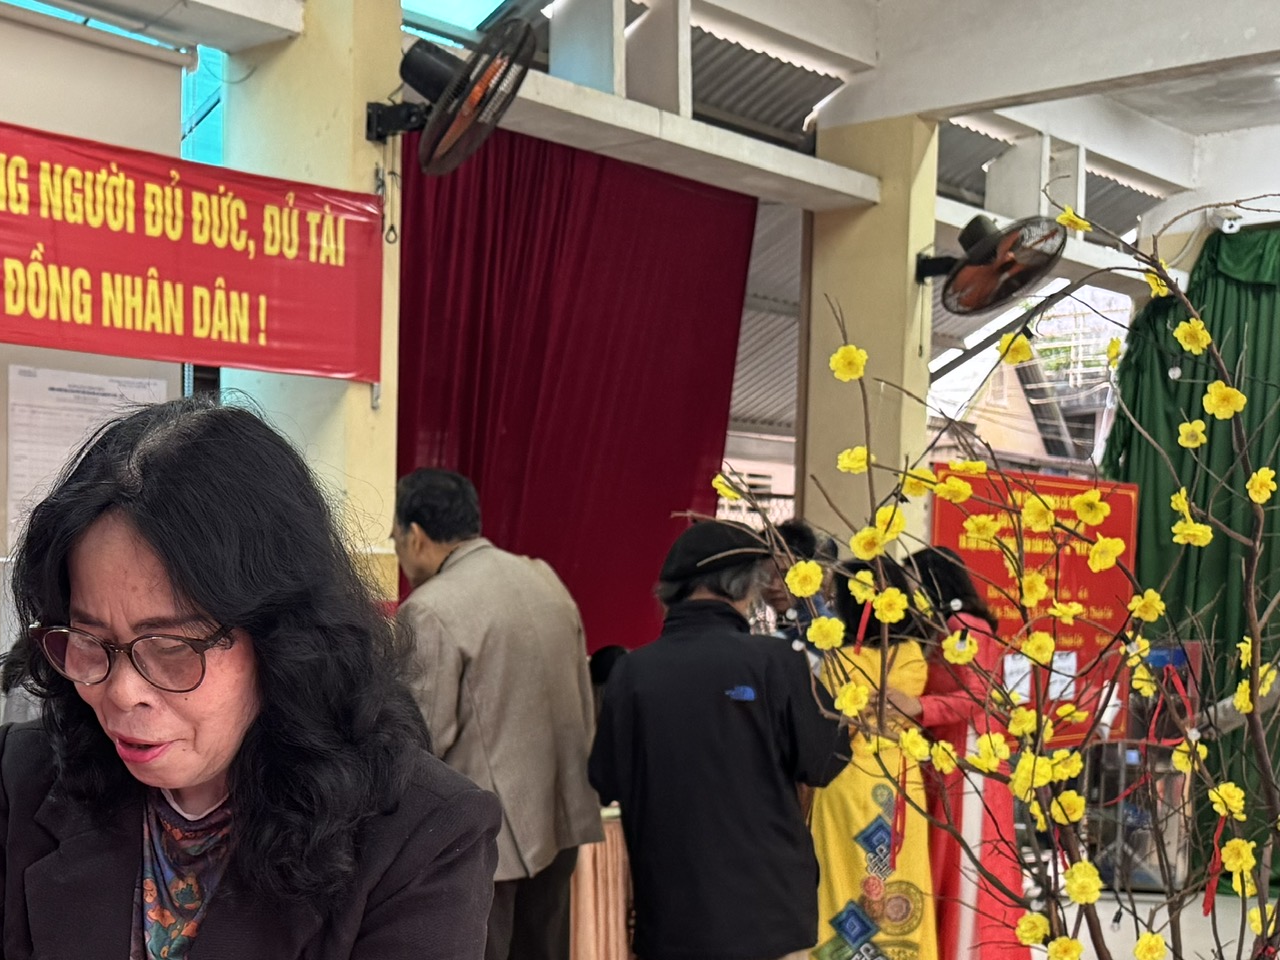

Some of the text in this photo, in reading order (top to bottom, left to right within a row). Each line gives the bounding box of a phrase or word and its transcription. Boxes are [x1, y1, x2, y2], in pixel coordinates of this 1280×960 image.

[39, 161, 135, 234] NGƯỜI
[144, 170, 183, 242] ĐỦ
[191, 184, 256, 260] ĐỨC,
[263, 191, 299, 259] ĐỦ
[306, 204, 345, 267] TÀI
[3, 242, 93, 325] ĐỒNG
[101, 266, 184, 336] NHÂN
[192, 276, 250, 345] DÂN
[258, 294, 267, 346] !
